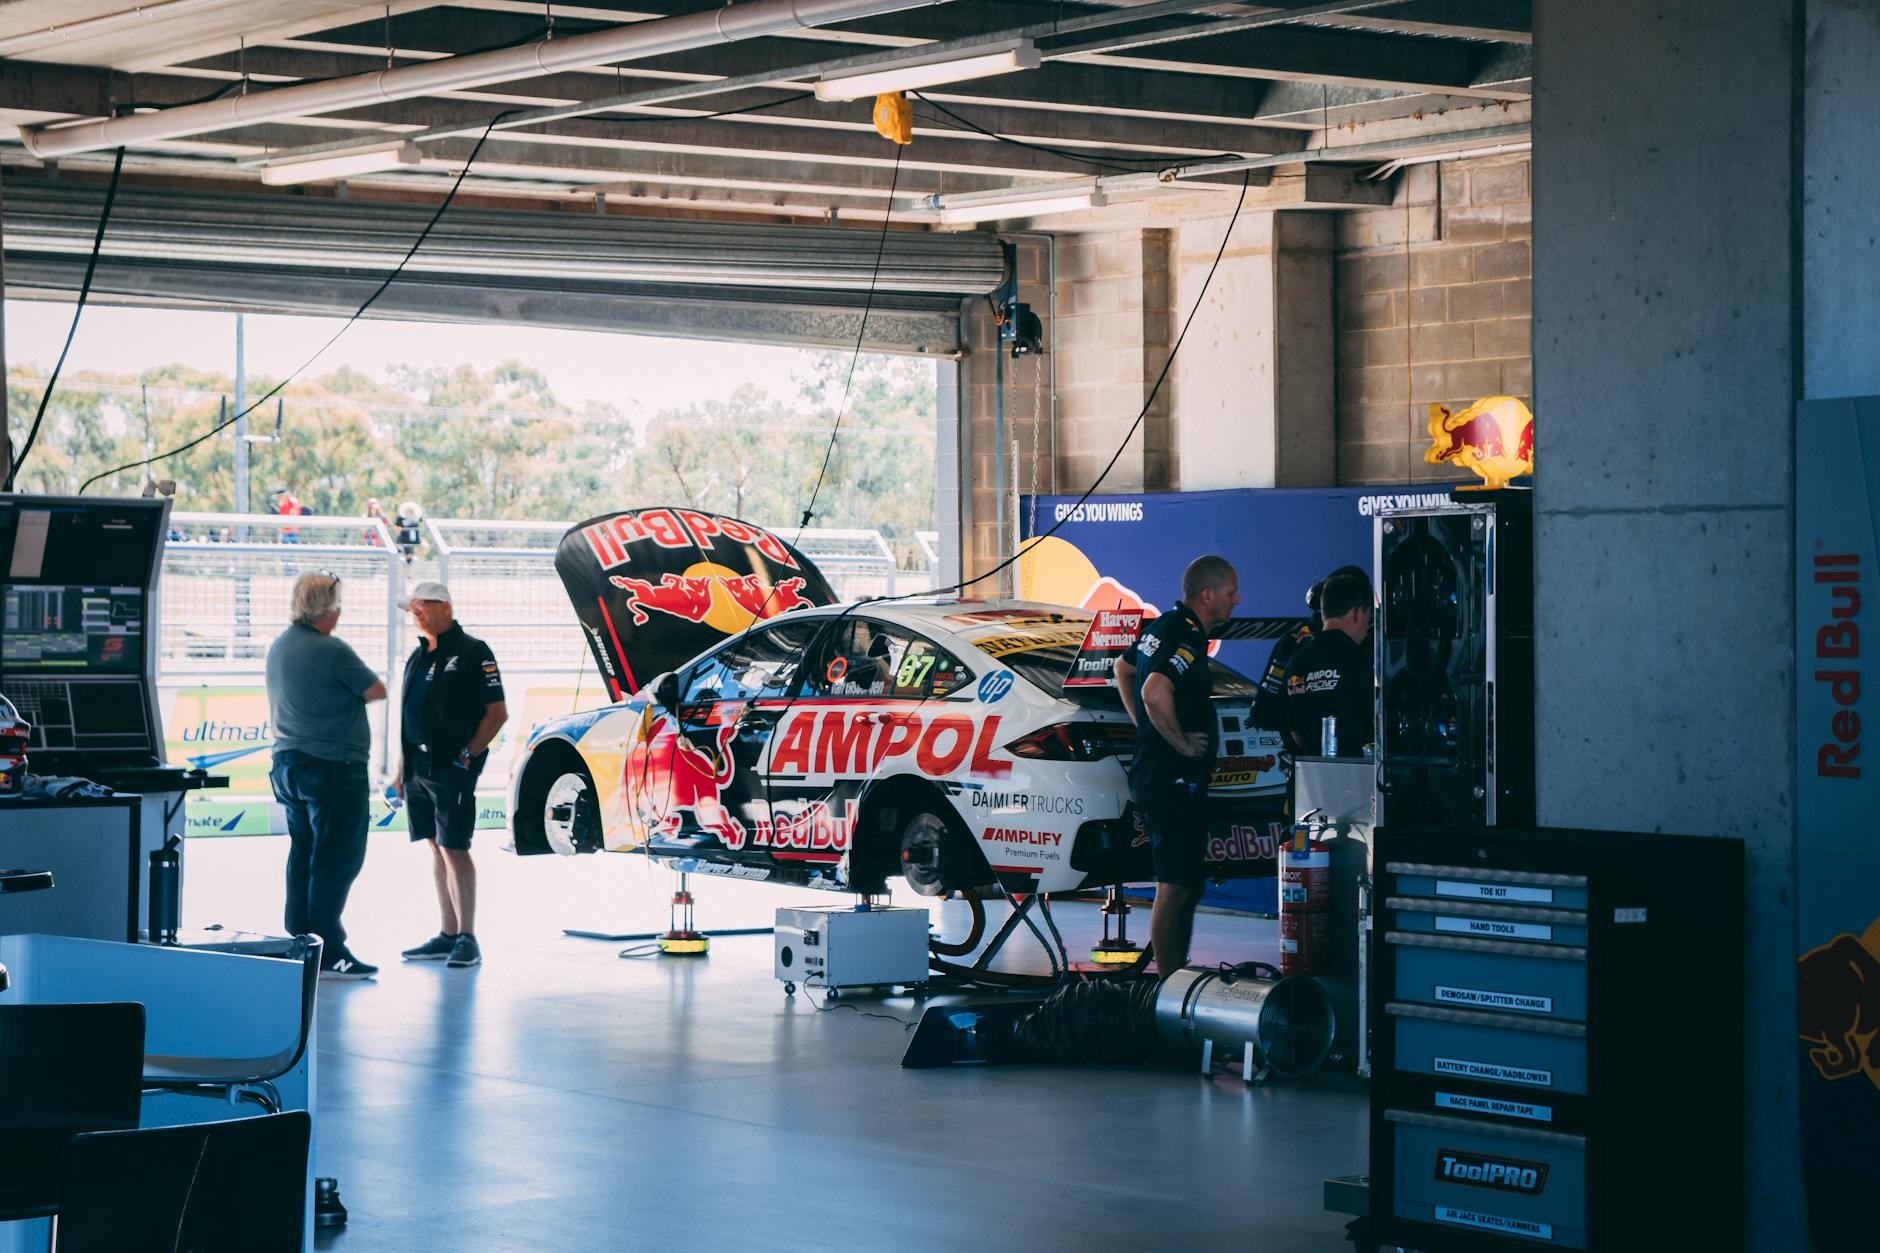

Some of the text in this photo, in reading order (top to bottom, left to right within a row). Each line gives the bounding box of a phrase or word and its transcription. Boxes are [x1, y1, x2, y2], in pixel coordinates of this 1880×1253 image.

[1421, 493, 1451, 507] WIN
[1055, 503, 1143, 522] GIVES YOU WINGS
[580, 508, 801, 571] Red Bull
[1100, 611, 1141, 629] Harvey
[1091, 631, 1136, 647] Norman
[593, 634, 616, 676] DUNLOP
[1077, 657, 1117, 672] ToolP
[896, 655, 936, 688] 97
[1814, 554, 1860, 777] Red Bull
[979, 670, 1012, 704] hp
[183, 720, 270, 742] ultimat
[769, 710, 1013, 779] AMPOL
[1215, 773, 1251, 783] AUTO
[972, 791, 1083, 815] DAIMLER TRUCKS
[993, 828, 1063, 847] AMPLIFY
[1005, 847, 1061, 861] Premium Fuels
[1480, 887, 1507, 897] TOE KIT
[1470, 922, 1515, 934] HAND TOOLS
[1441, 989, 1545, 1008] DEMOSAW/SPLITTER CHANGE
[1437, 1061, 1548, 1083] BATTERY CHANGE/RADBLOWER
[1449, 1096, 1535, 1115] RACE PANEL REPAIR TAPE
[1442, 1156, 1538, 1189] ToolPRO
